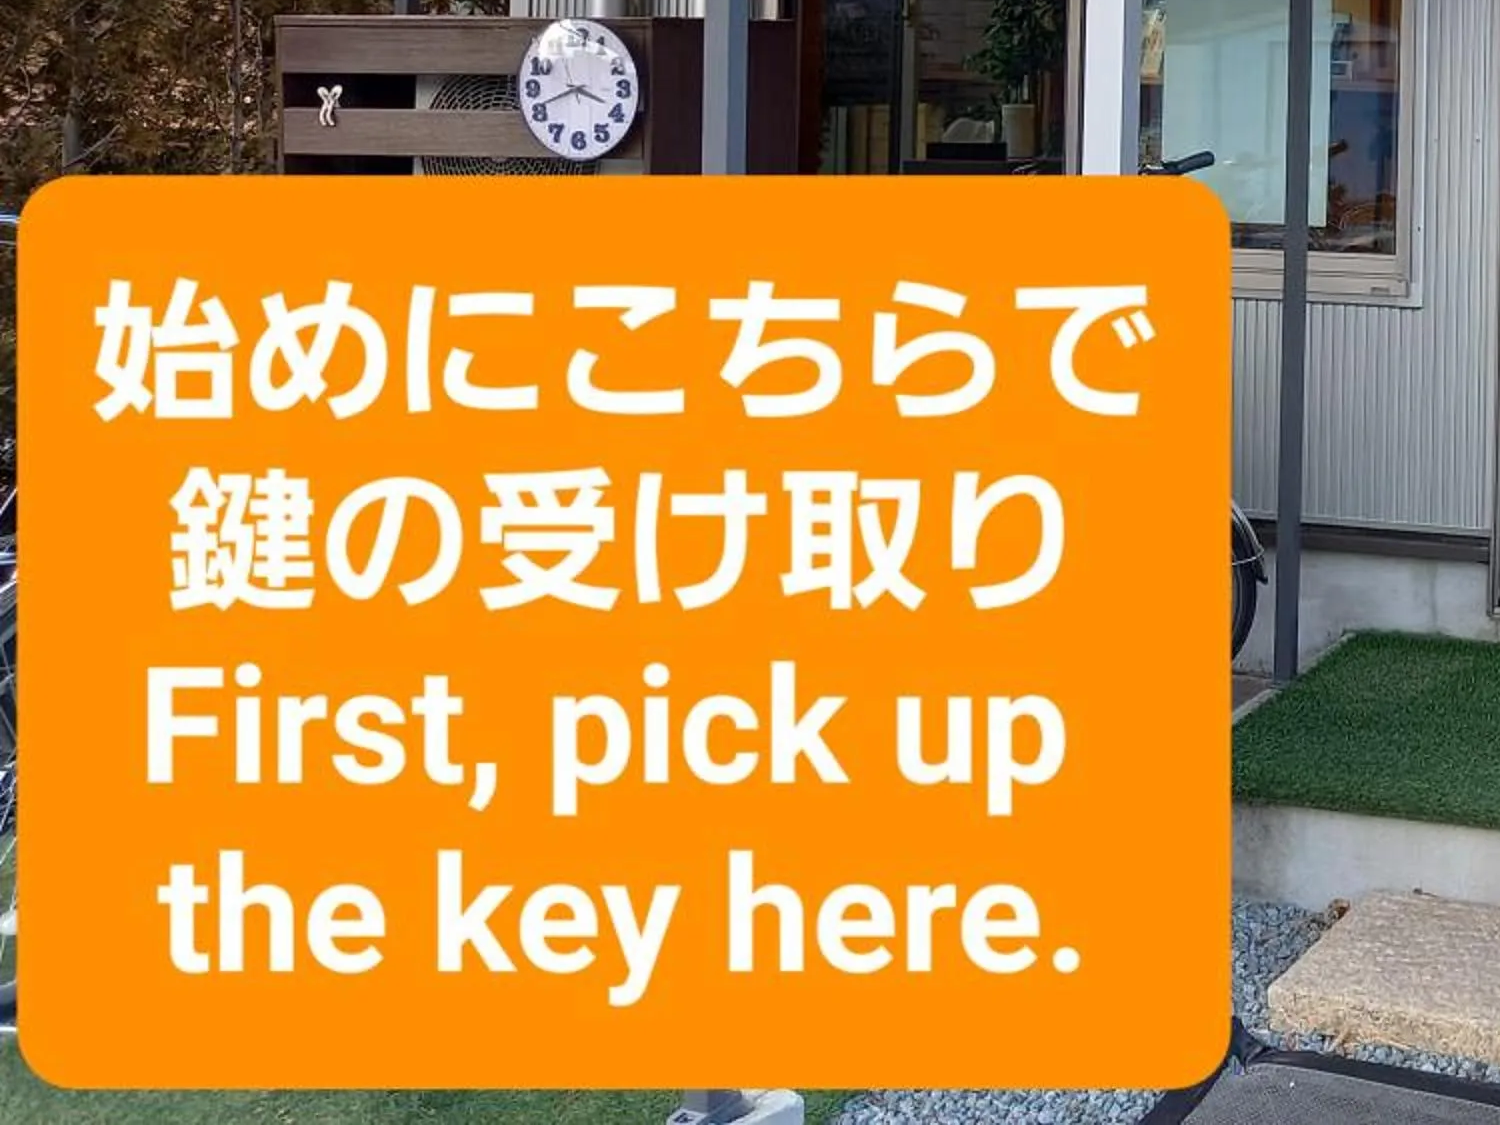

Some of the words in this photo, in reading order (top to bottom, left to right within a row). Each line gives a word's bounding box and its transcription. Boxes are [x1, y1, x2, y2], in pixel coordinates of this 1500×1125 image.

[531, 57, 552, 75] 10
[611, 57, 625, 75] 2
[525, 79, 541, 98] 9
[616, 79, 631, 99] 3
[532, 103, 548, 122] 8
[608, 103, 625, 123] 4
[548, 123, 564, 143] 7
[571, 131, 586, 150] 6
[594, 123, 610, 143] 5
